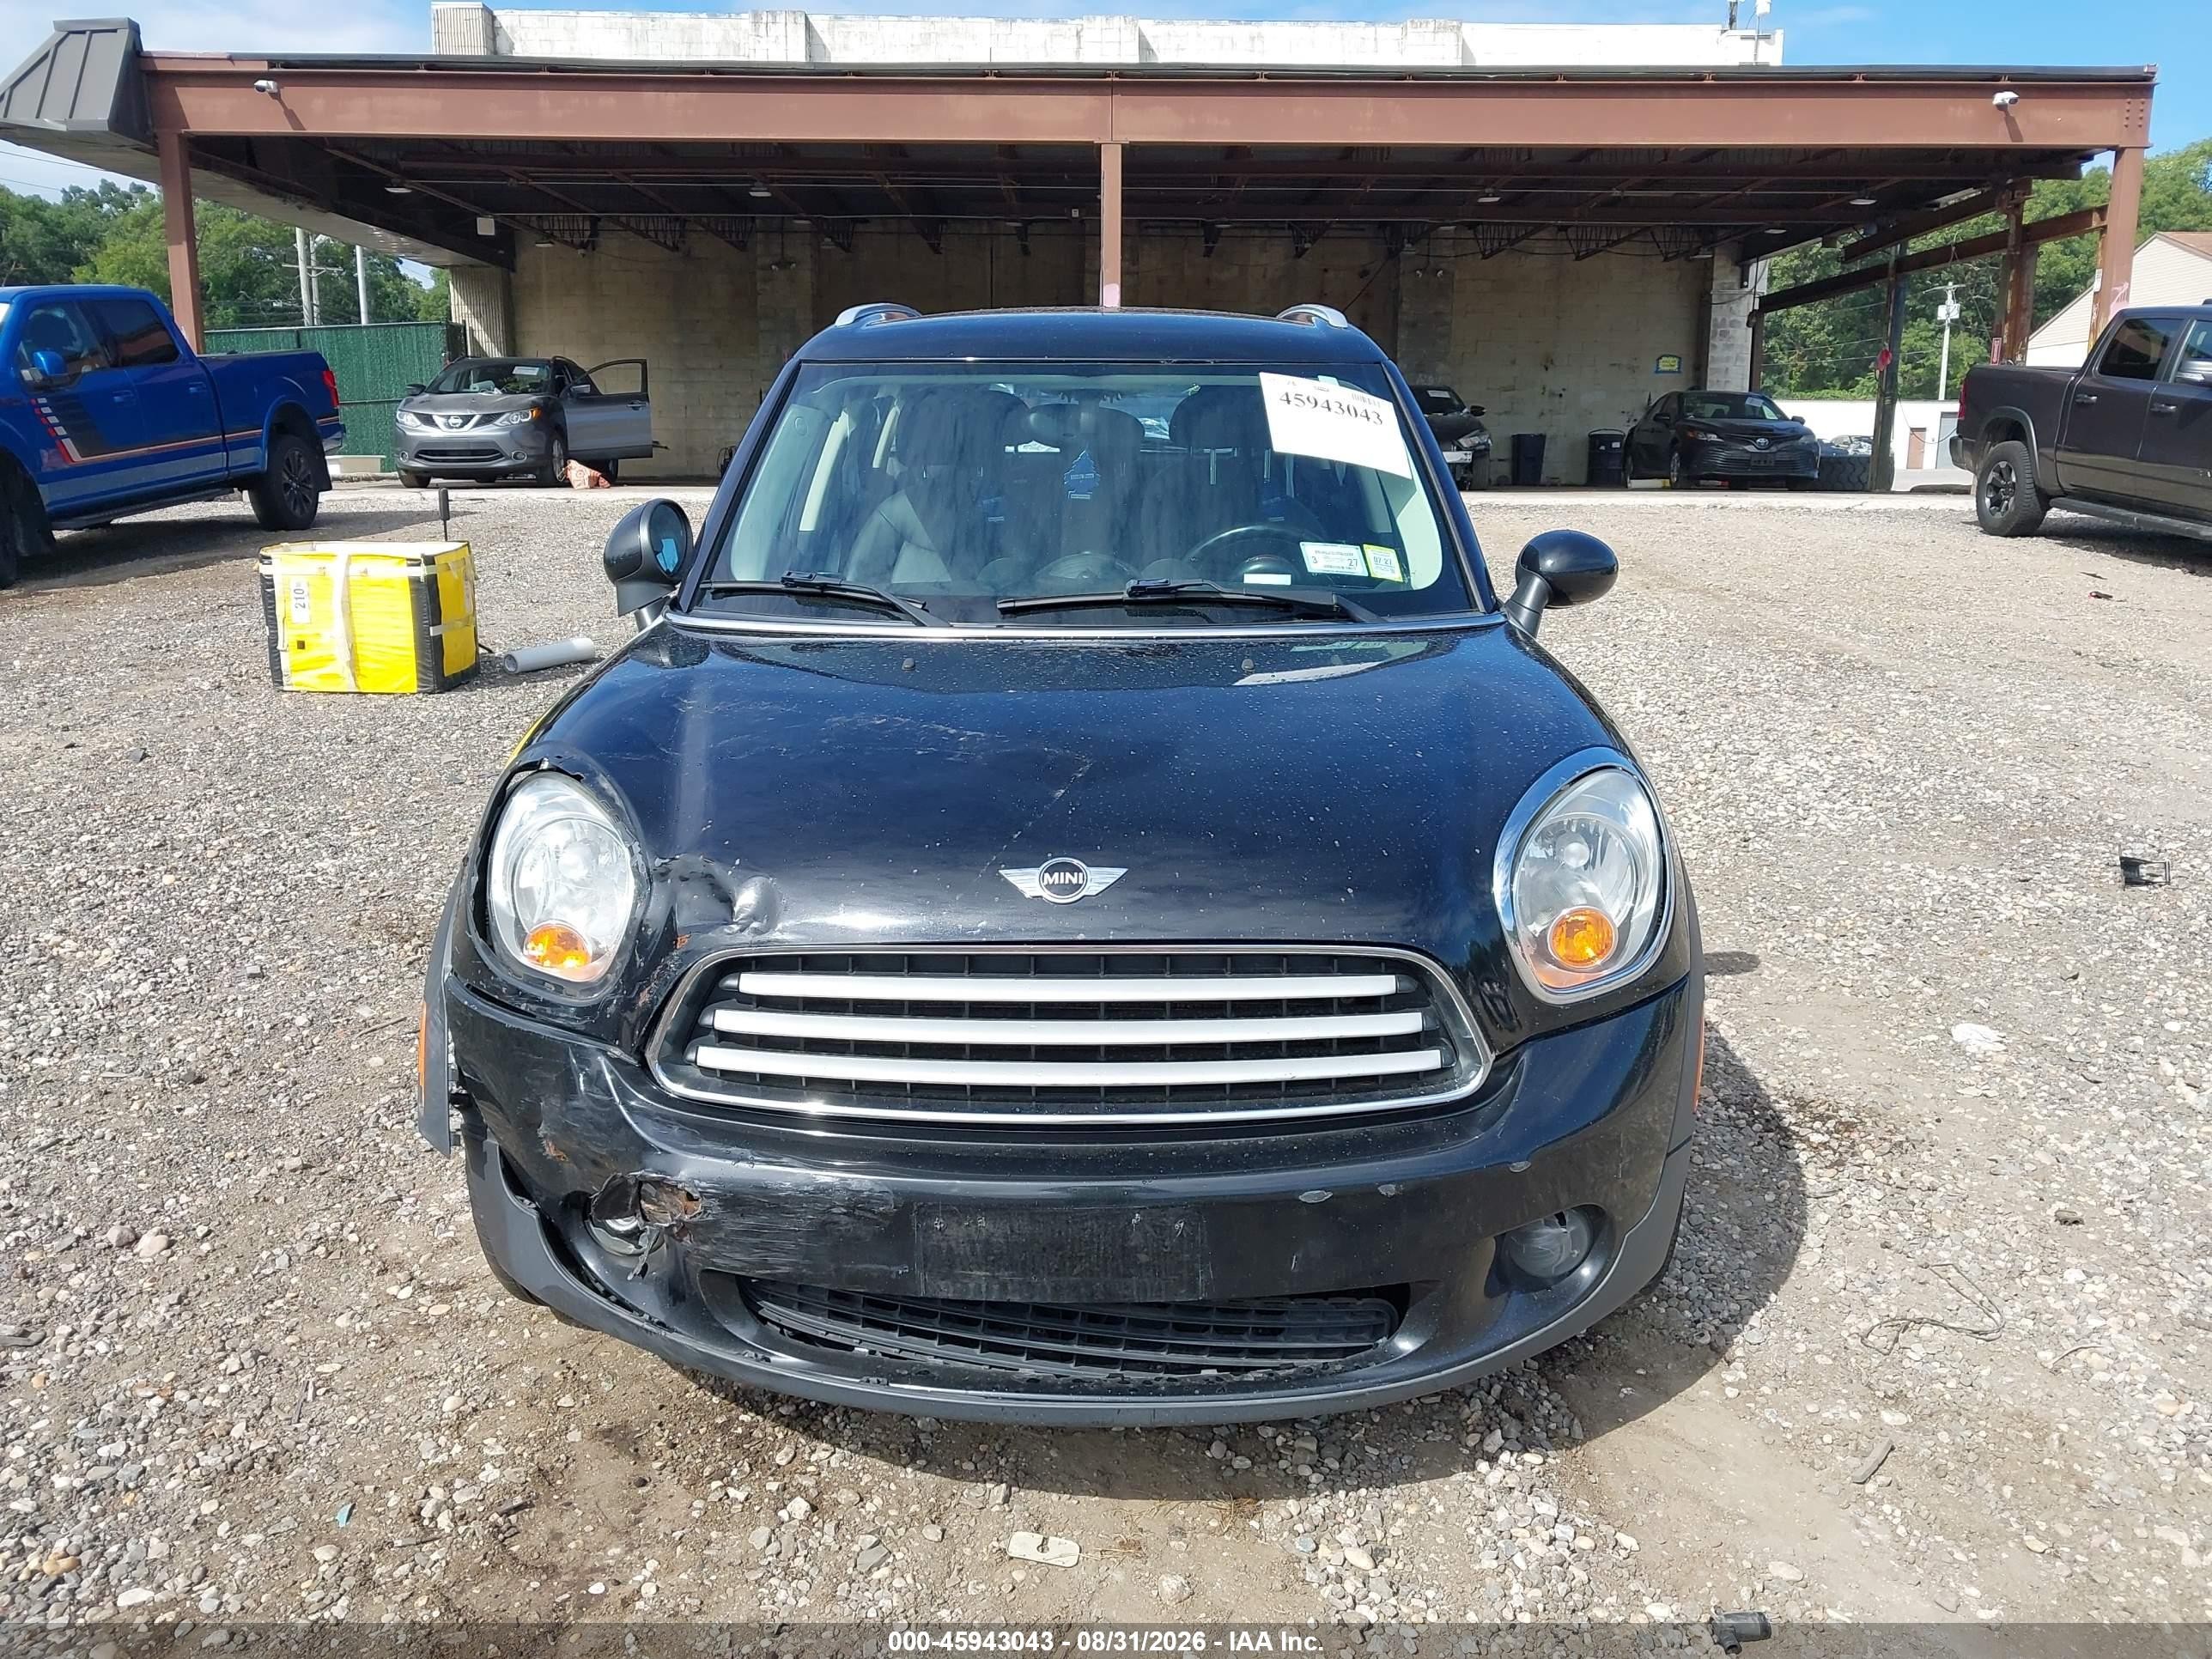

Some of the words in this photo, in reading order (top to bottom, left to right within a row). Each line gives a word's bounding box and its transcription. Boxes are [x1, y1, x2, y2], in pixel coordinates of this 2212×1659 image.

[1279, 392, 1383, 425] 45943043
[1346, 558, 1358, 567] 27
[293, 588, 307, 609] 210
[1042, 872, 1084, 885] MINI
